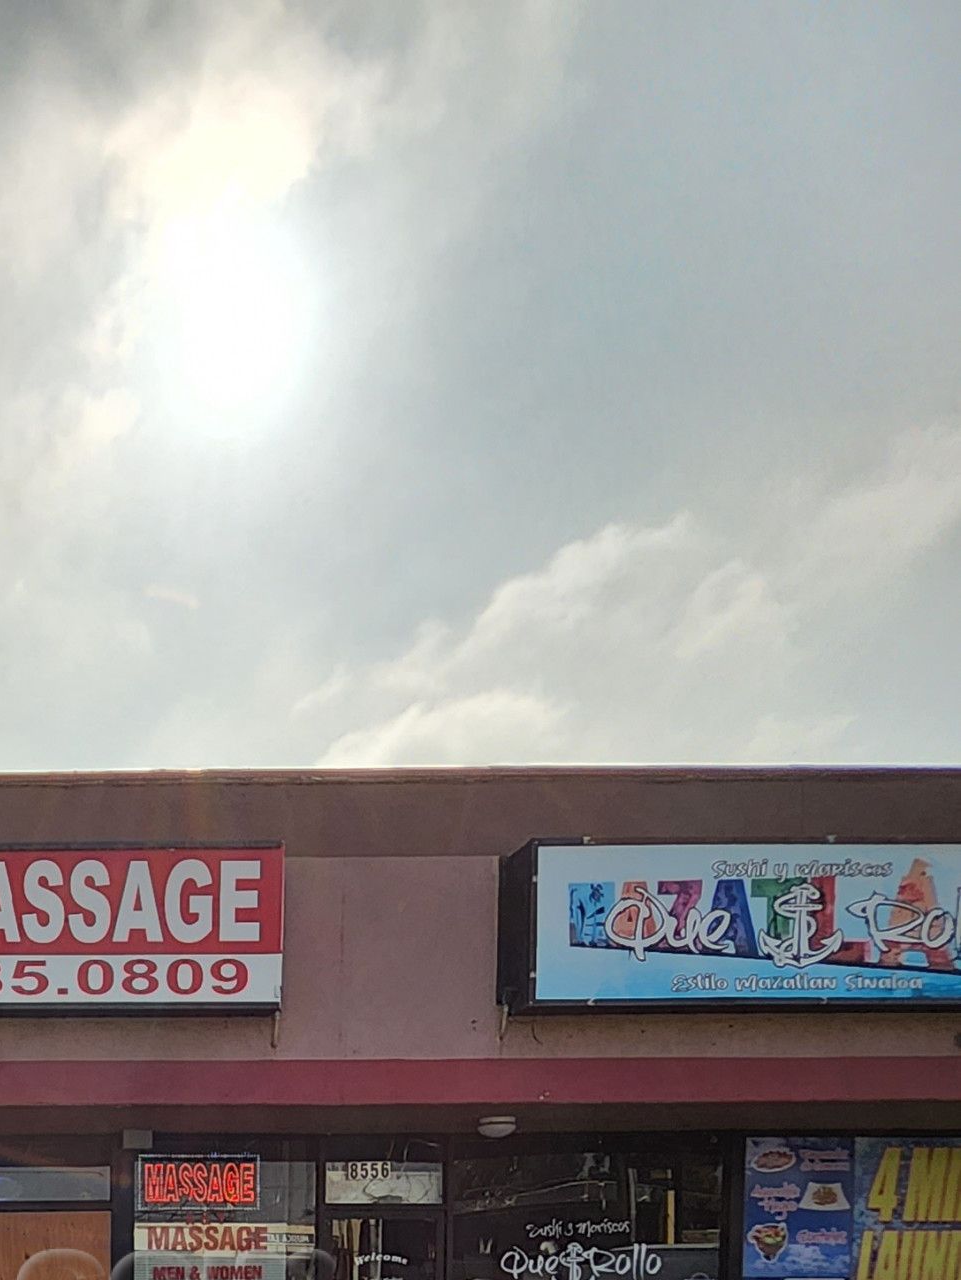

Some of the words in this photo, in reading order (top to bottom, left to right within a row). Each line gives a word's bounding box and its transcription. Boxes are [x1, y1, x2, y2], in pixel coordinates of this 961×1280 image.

[711, 859, 767, 878] Sushi
[774, 862, 789, 880] y
[795, 861, 895, 878] Mariscos
[604, 885, 735, 962] Que
[671, 974, 728, 992] Estilo
[145, 1162, 256, 1202] MASSAGE
[349, 1163, 390, 1179] 8556
[867, 1146, 902, 1222] 4
[147, 1226, 269, 1250] MASSAGE
[153, 1266, 185, 1280] MEN
[189, 1266, 201, 1280] &
[207, 1265, 263, 1280] WOMEN
[500, 1245, 558, 1280] Que
[583, 1243, 662, 1280] Rollo
